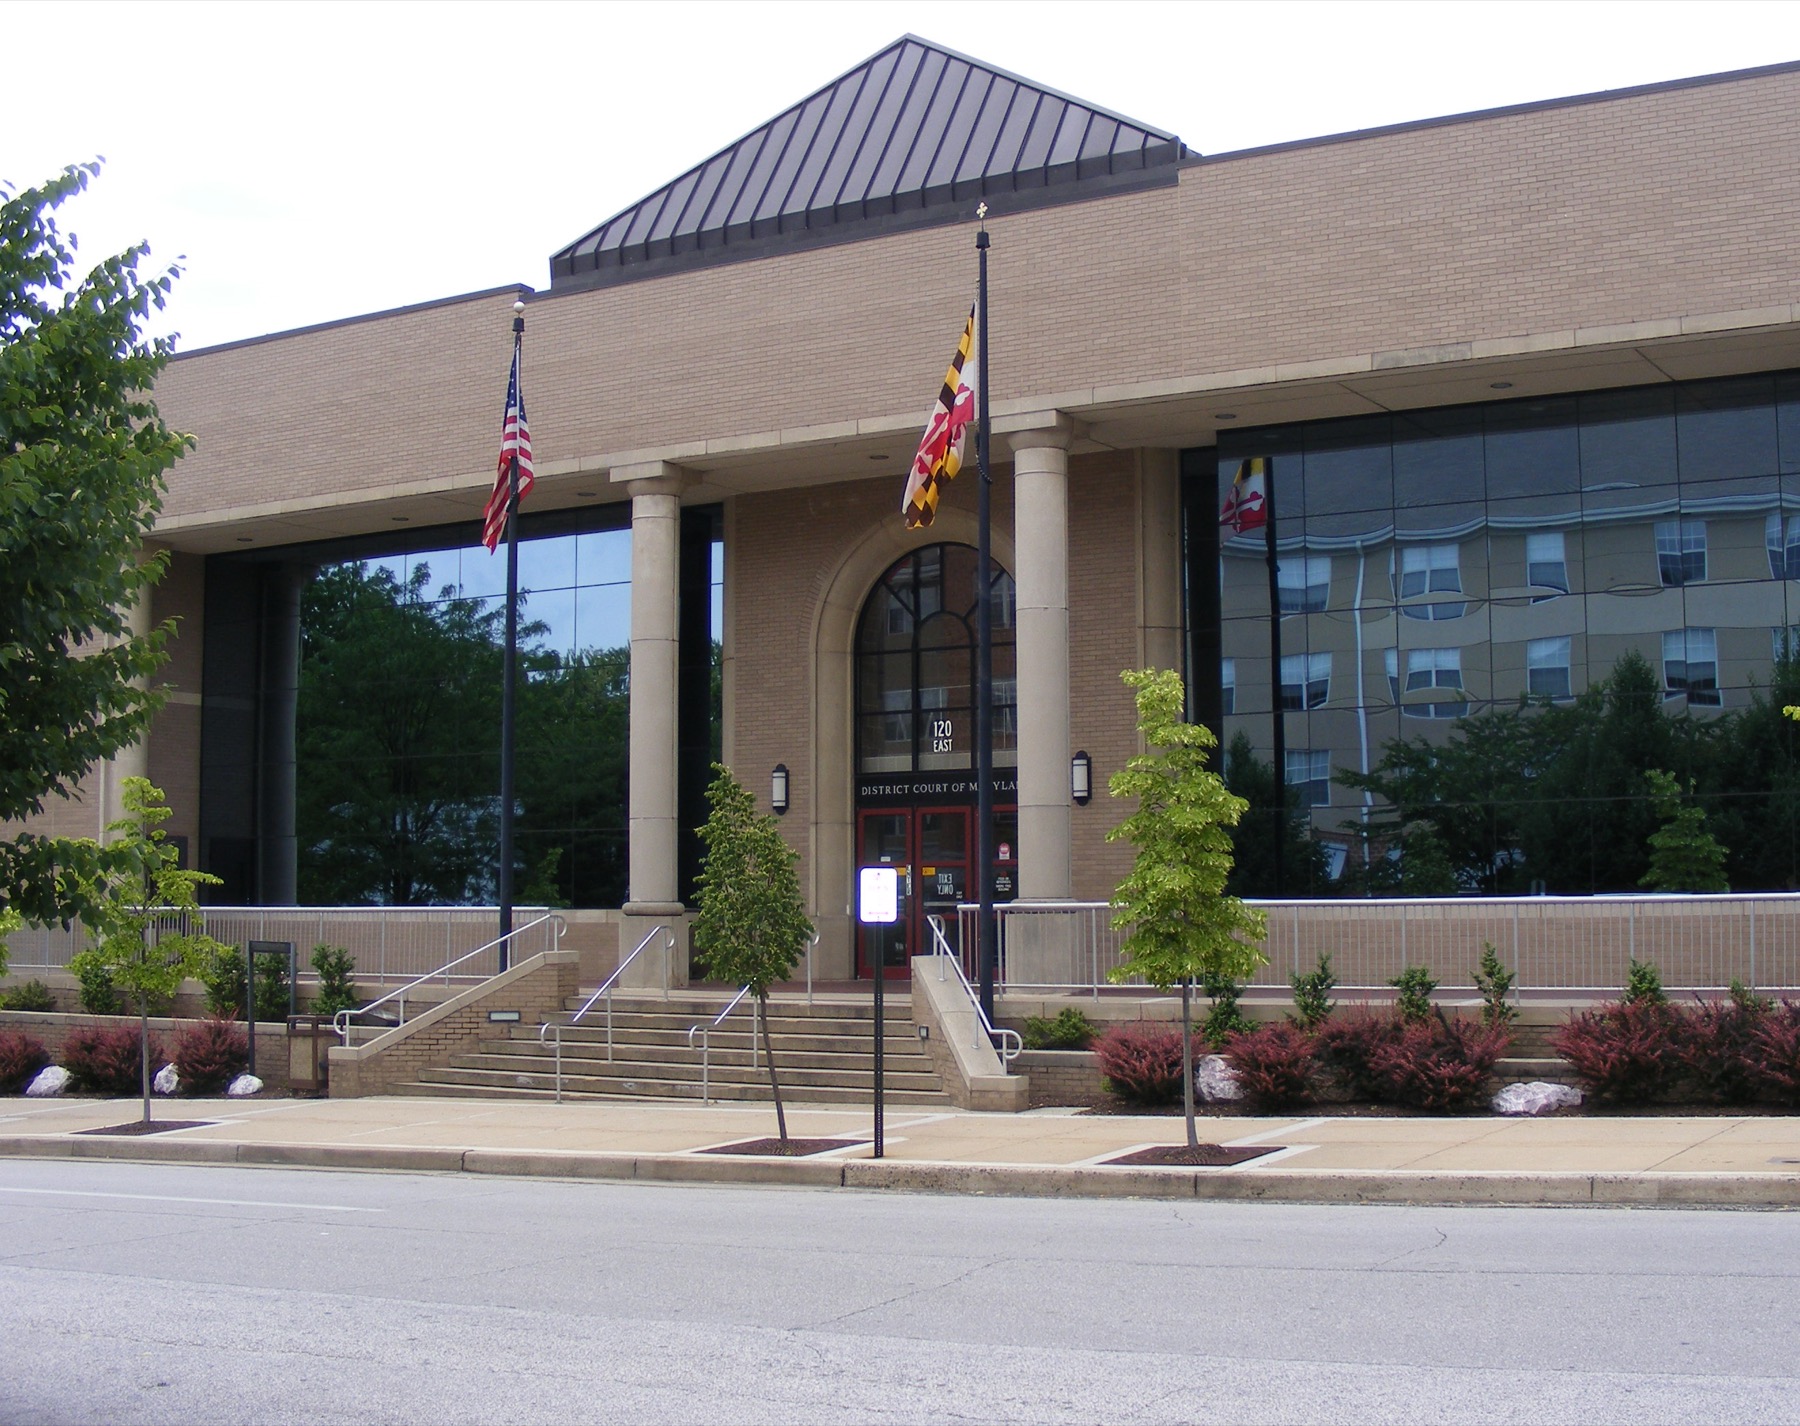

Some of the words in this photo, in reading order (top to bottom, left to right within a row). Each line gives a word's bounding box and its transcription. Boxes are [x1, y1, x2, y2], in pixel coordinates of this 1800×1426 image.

[933, 720, 952, 737] 120
[933, 739, 952, 752] EAST
[861, 784, 910, 796] DISTRICT
[913, 783, 949, 794] COURT
[951, 782, 966, 792] OF
[969, 780, 1018, 791] MYLA
